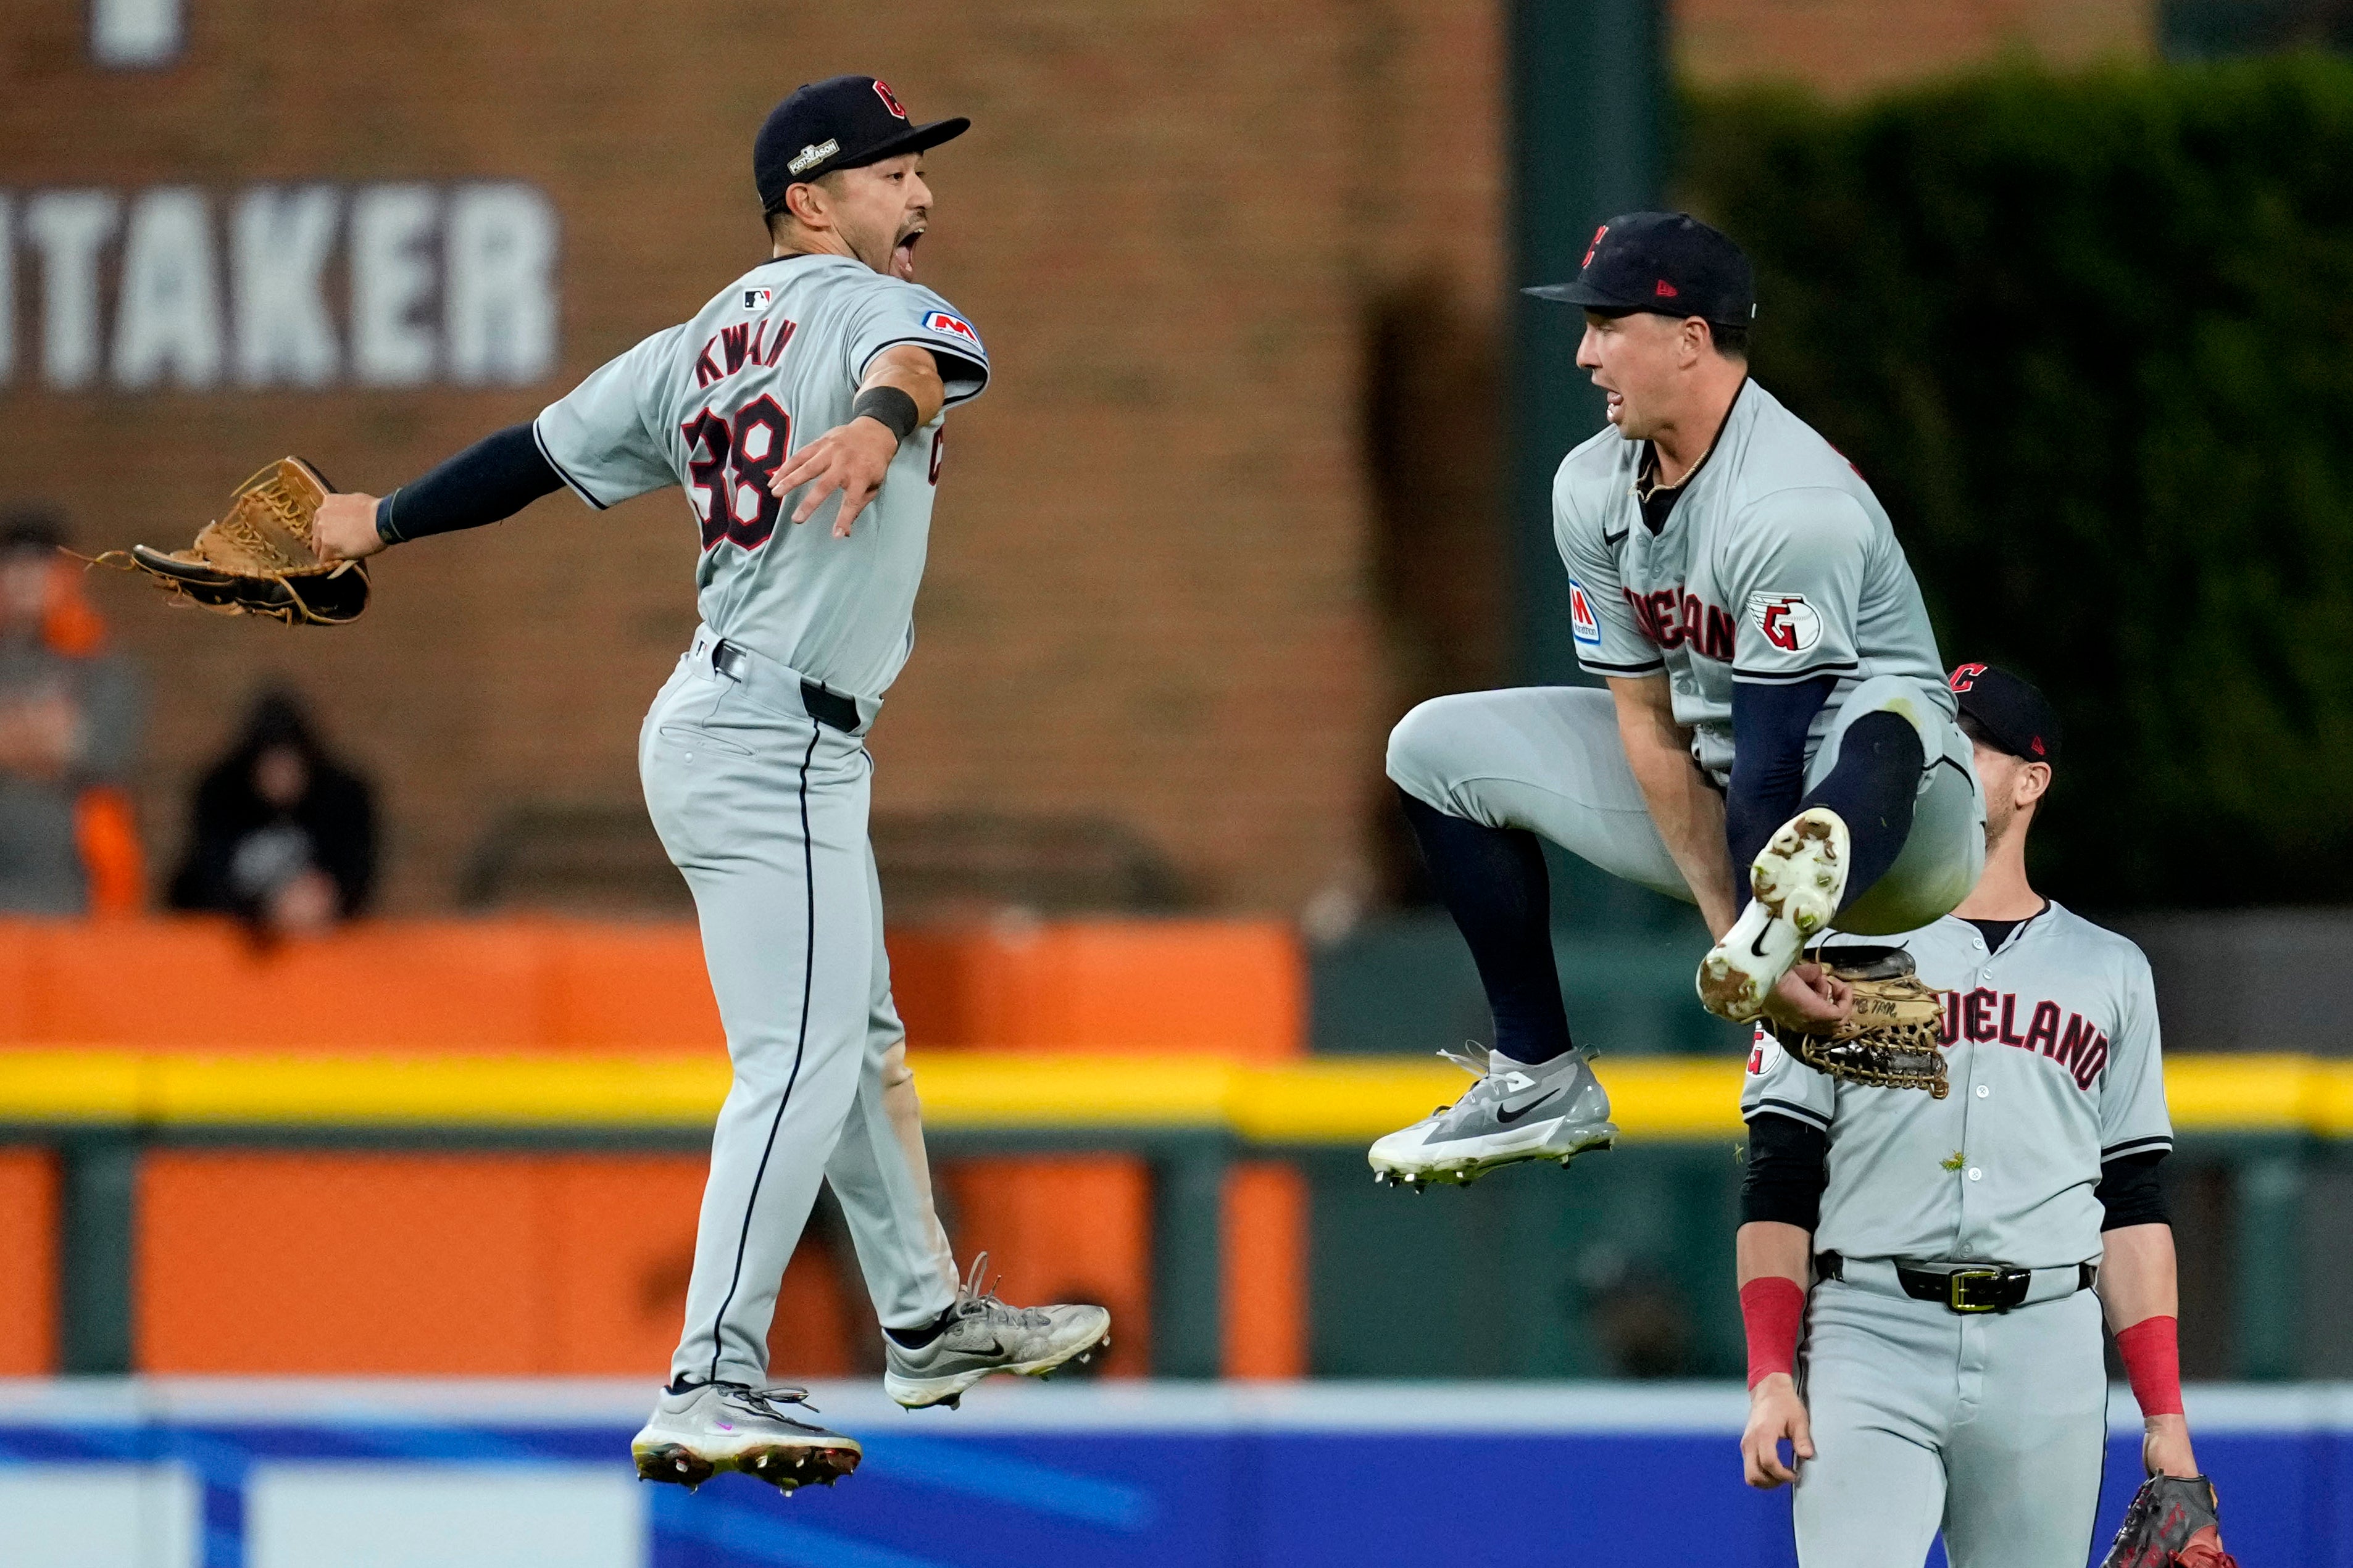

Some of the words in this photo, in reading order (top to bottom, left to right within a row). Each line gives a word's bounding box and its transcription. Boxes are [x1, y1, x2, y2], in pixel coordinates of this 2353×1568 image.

[872, 80, 906, 120] C
[790, 141, 837, 173] POSTSEASON
[0, 183, 559, 388] TAKER
[681, 392, 791, 552] 38
[1949, 663, 1988, 694] C
